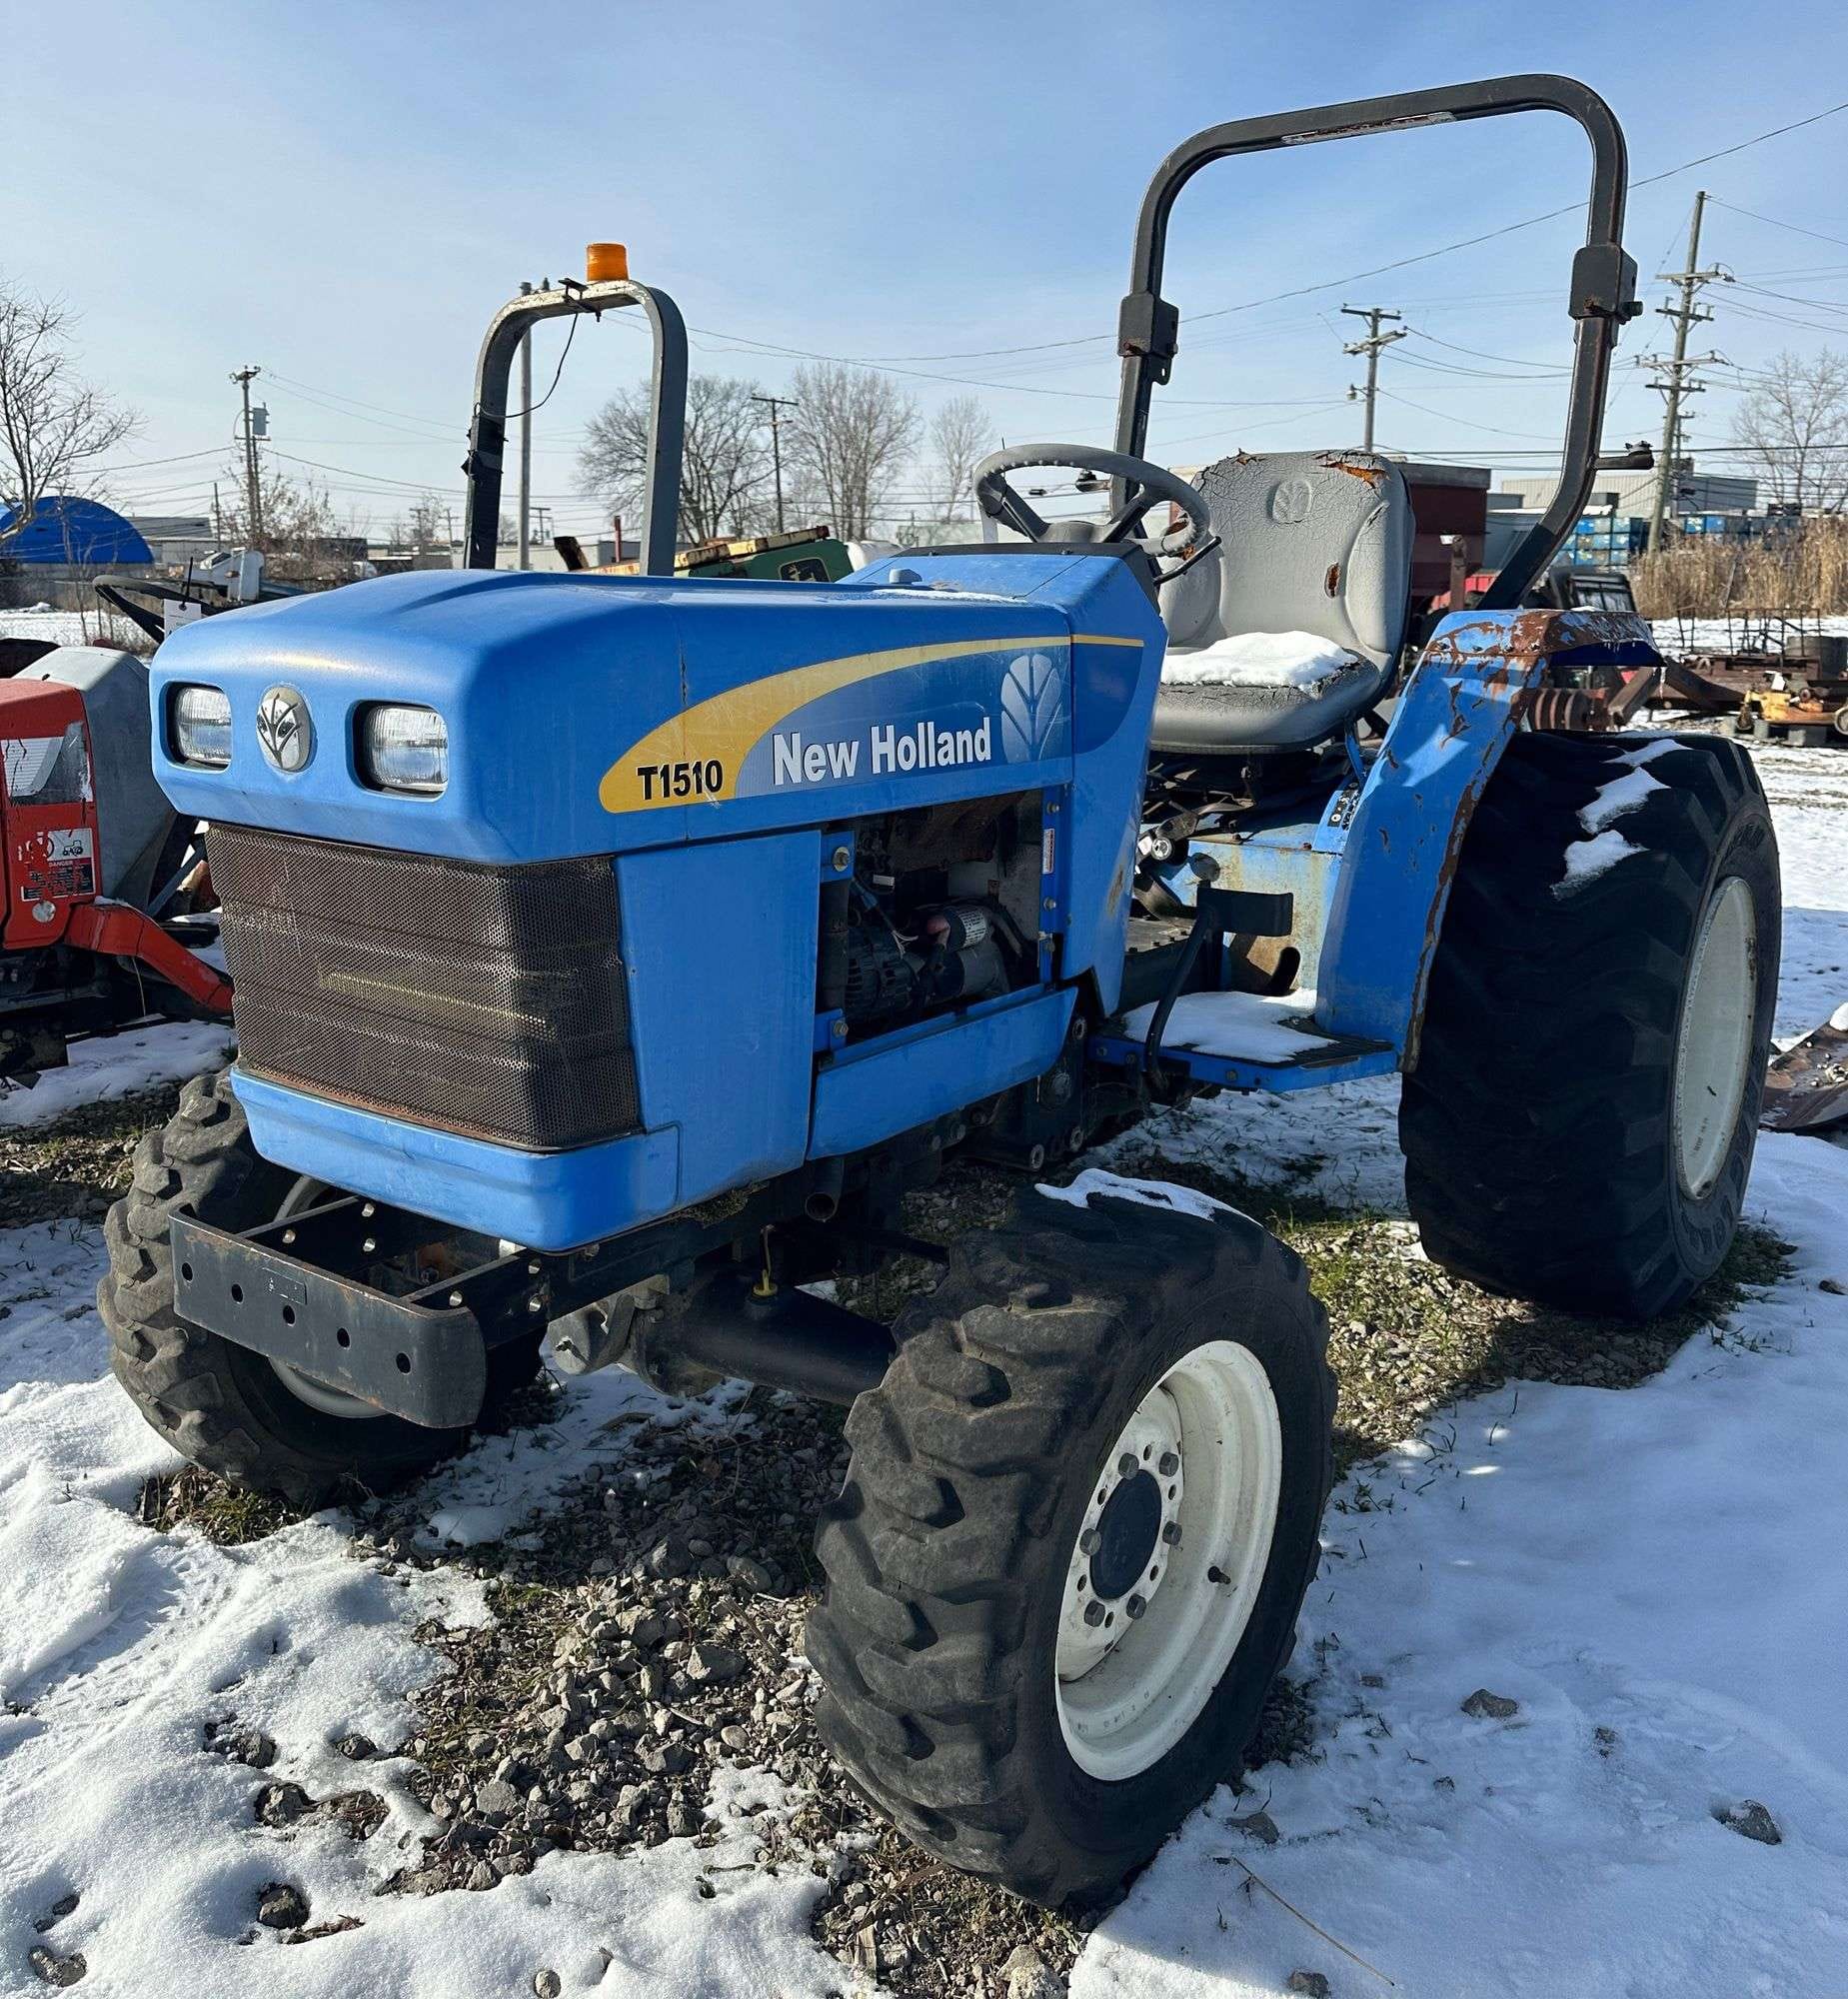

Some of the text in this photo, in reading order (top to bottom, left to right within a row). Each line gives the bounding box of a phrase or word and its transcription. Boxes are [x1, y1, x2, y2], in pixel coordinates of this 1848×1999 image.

[772, 717, 992, 786] New Holland
[637, 759, 725, 801] T1510
